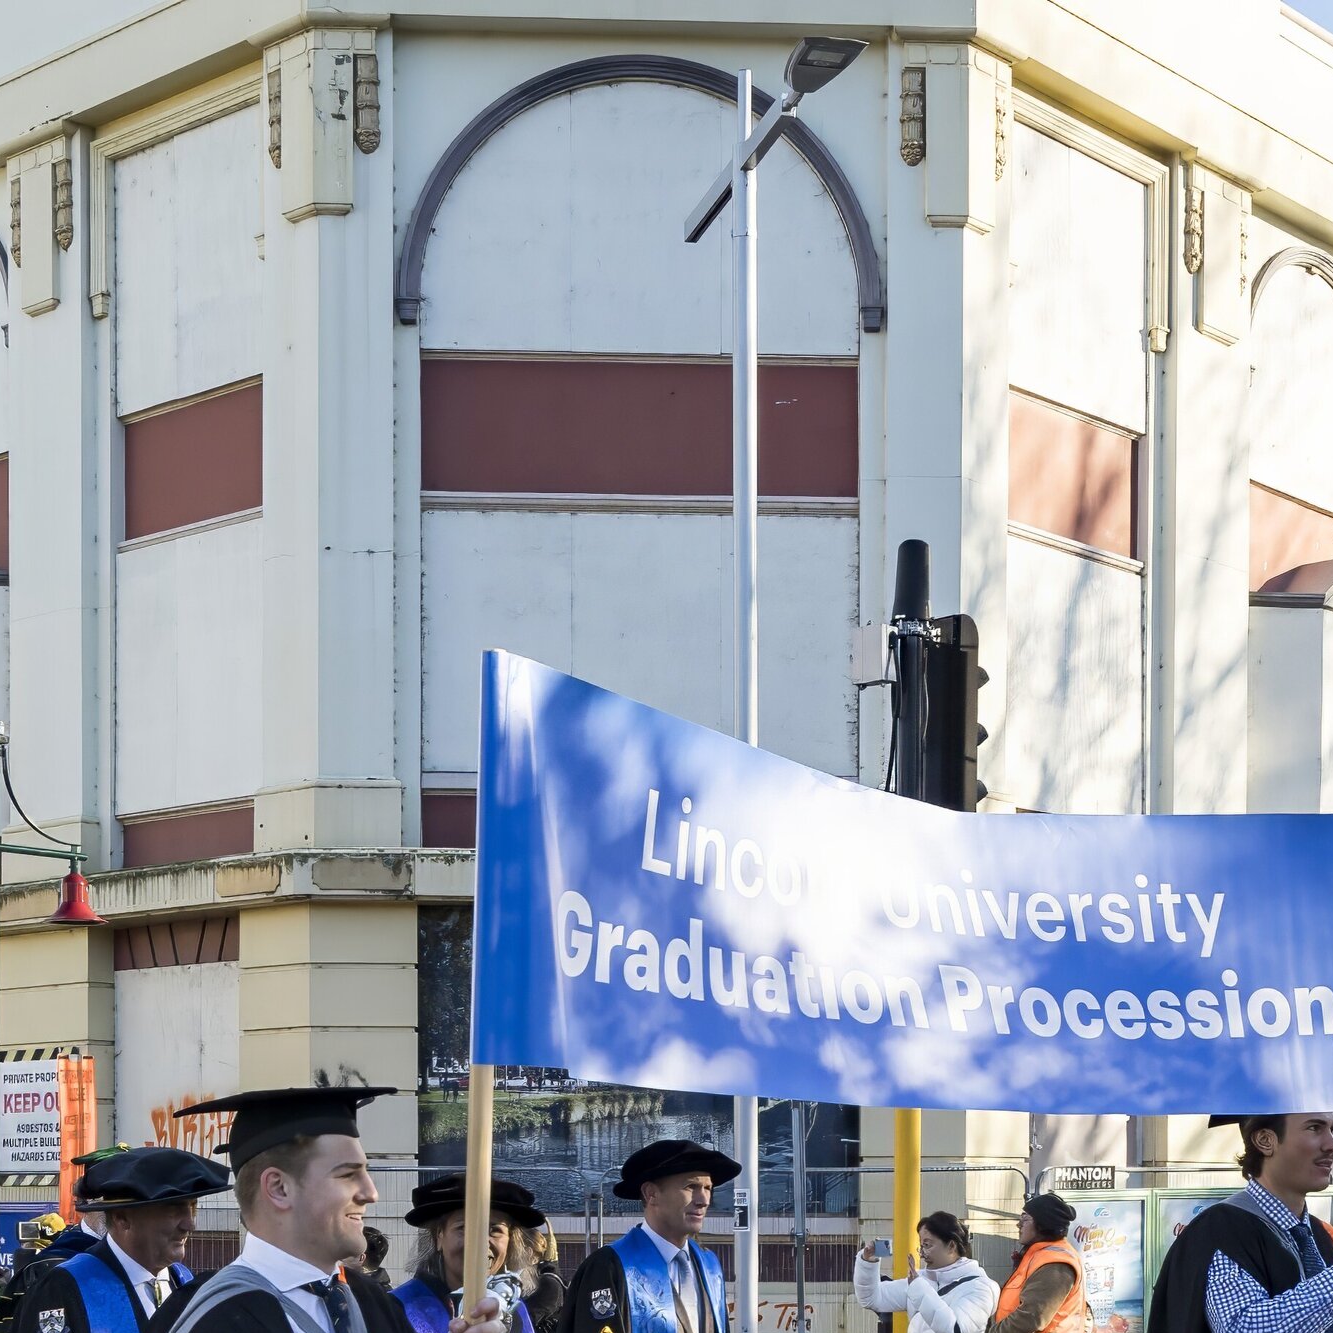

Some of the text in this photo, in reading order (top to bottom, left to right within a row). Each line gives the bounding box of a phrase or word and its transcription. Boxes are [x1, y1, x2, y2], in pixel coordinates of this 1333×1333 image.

[641, 788, 809, 908] Linco
[557, 890, 930, 1030] Graduation
[3, 1072, 59, 1084] PRIVATE PROP
[3, 1092, 41, 1114] KEEP
[16, 1123, 54, 1133] ASBESTOS
[2, 1136, 61, 1148] MULTIPLE BUILD
[11, 1152, 45, 1162] HAZARDS
[1055, 1167, 1113, 1181] PHANTOM
